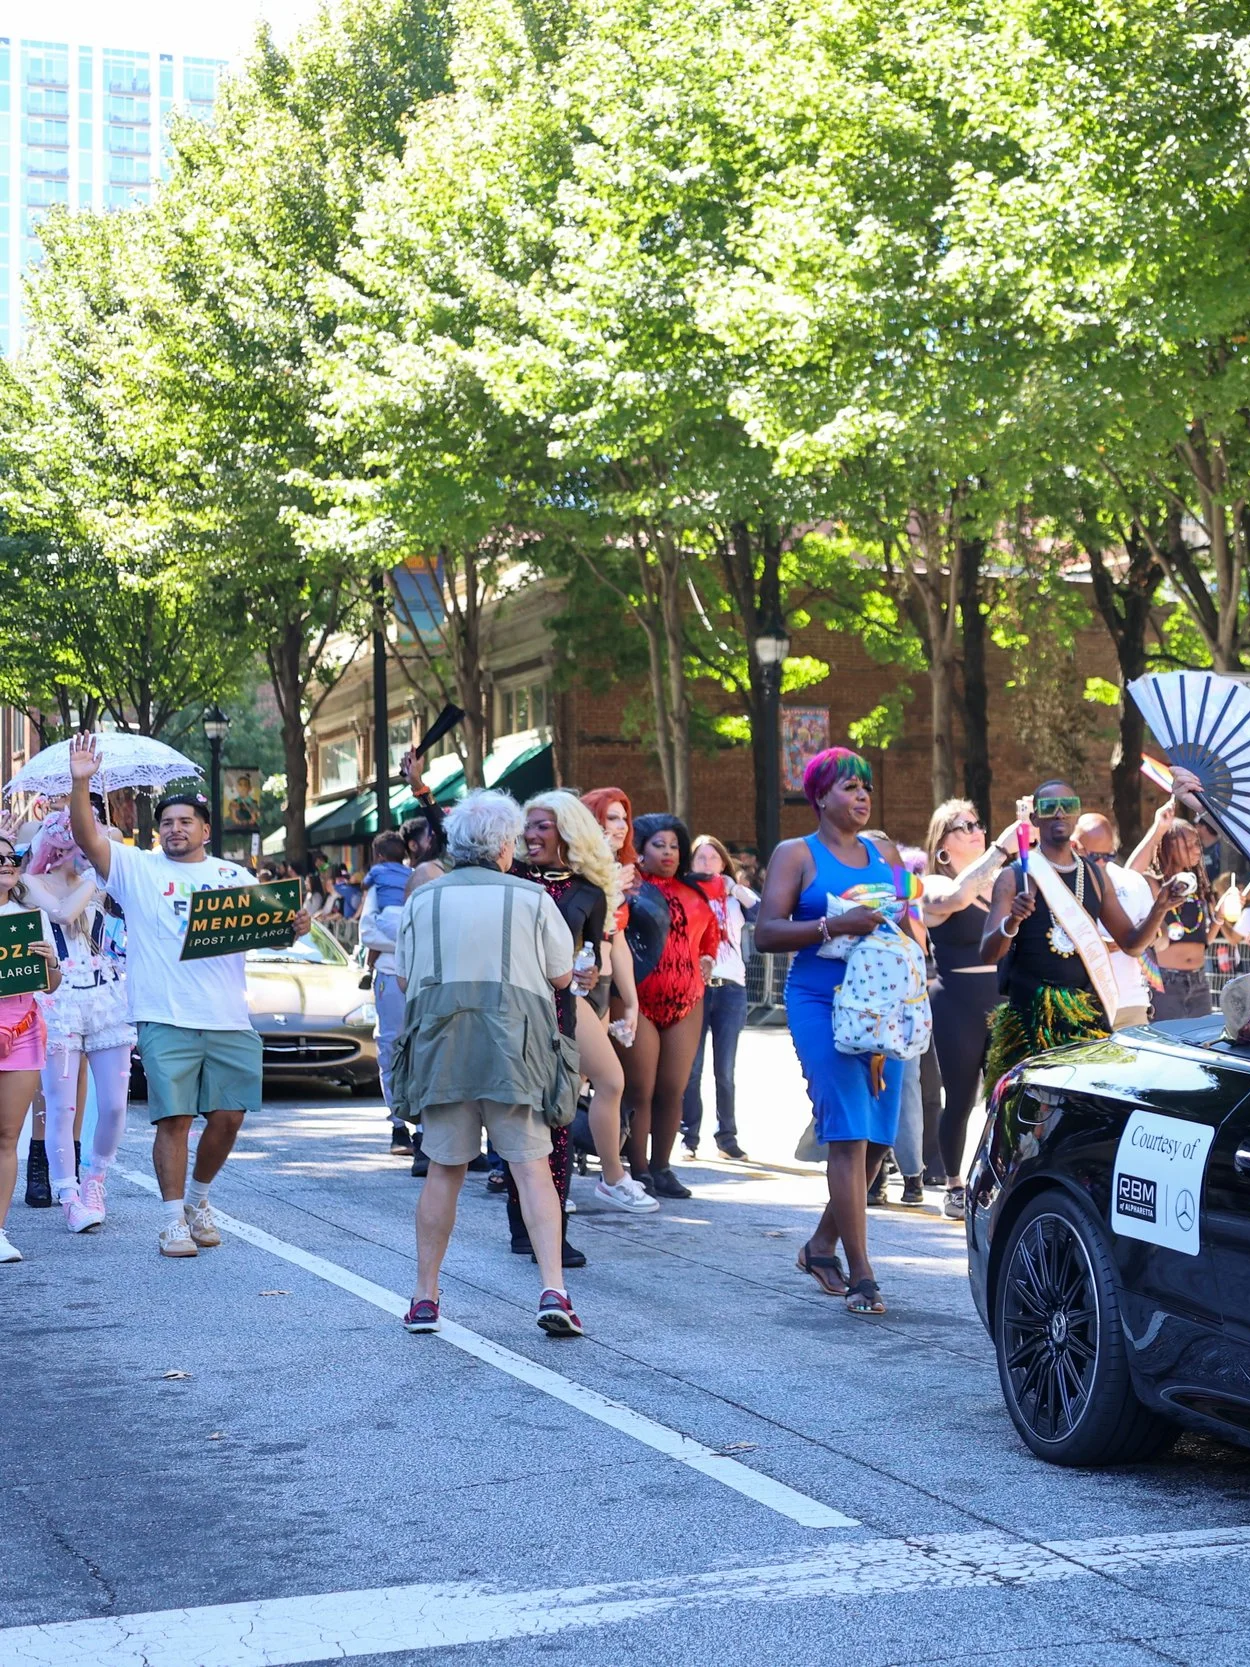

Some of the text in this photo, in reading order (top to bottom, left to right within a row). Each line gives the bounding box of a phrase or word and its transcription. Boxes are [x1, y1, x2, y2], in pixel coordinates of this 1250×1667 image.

[195, 894, 250, 913] JUAN
[191, 909, 297, 932] MENDOZA
[194, 935, 226, 947] POST
[238, 932, 252, 942] AT
[254, 927, 291, 940] LARGE
[0, 964, 41, 979] LARGE
[1131, 1125, 1201, 1161] Courtesy of
[1119, 1177, 1154, 1205] RBM
[1125, 1202, 1154, 1218] ALPHARETTA
